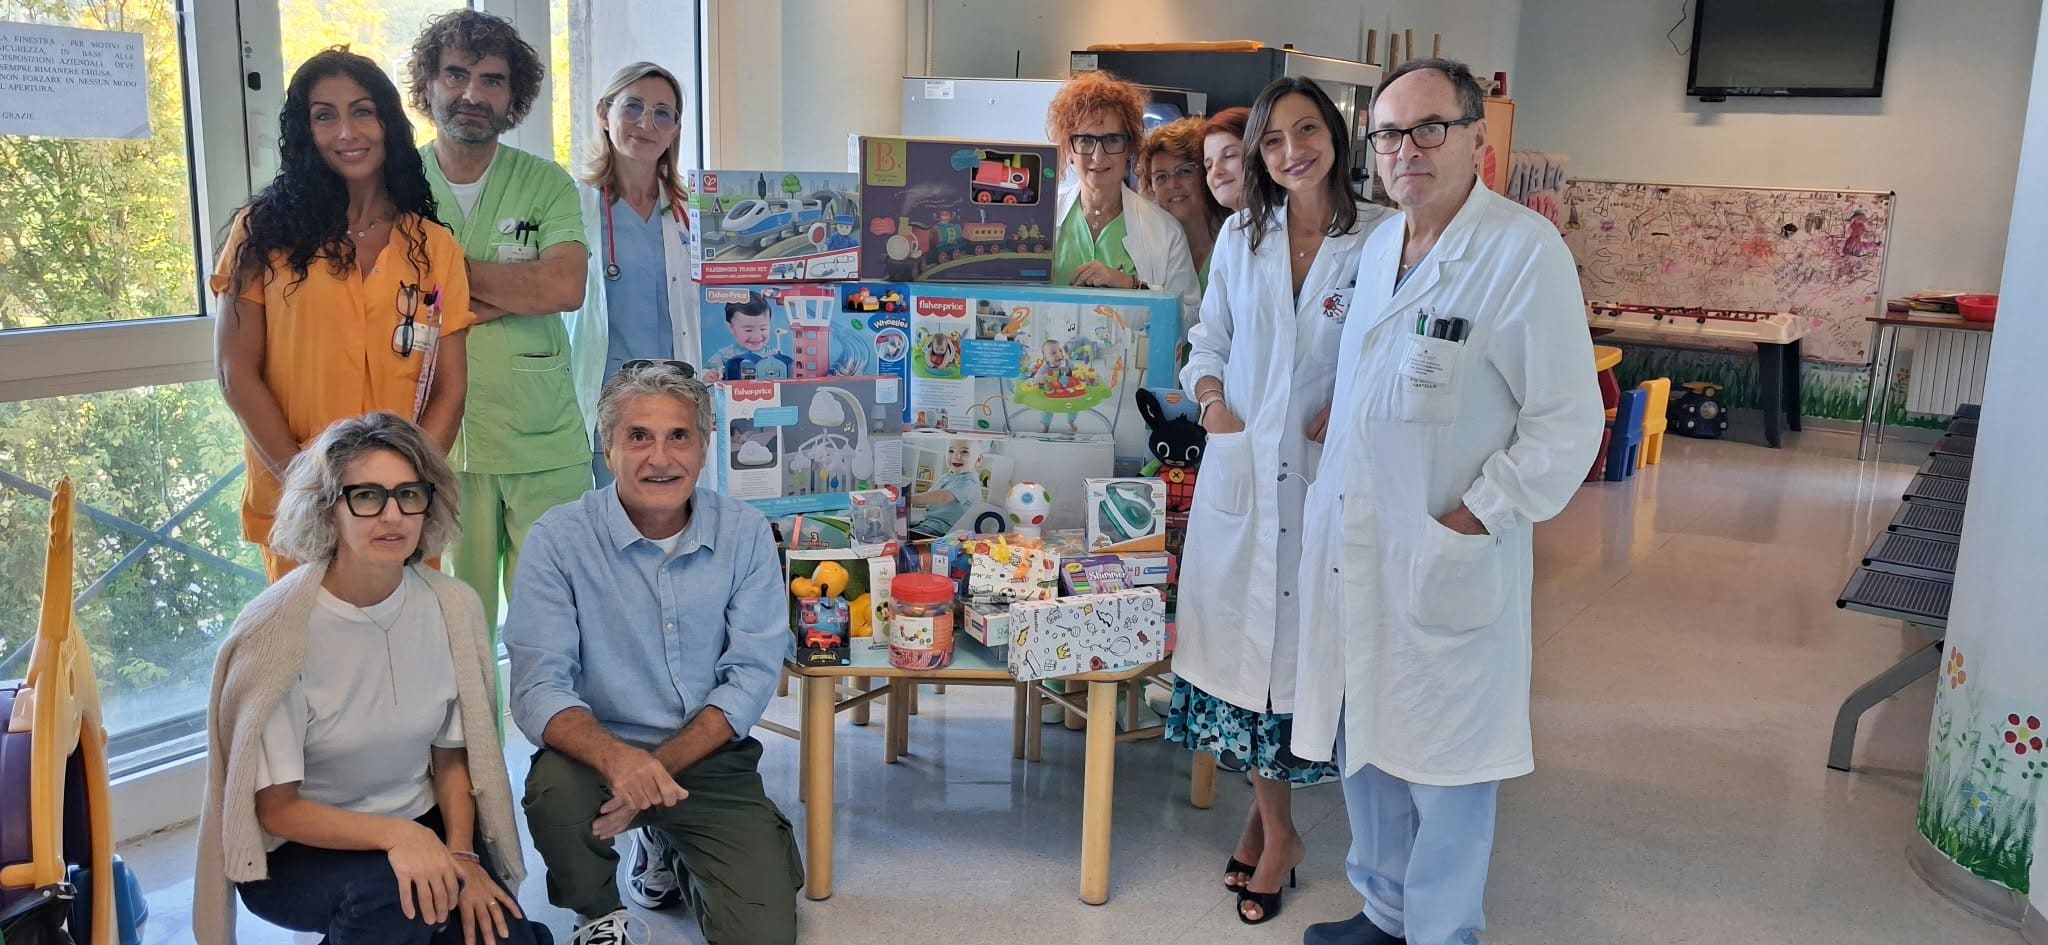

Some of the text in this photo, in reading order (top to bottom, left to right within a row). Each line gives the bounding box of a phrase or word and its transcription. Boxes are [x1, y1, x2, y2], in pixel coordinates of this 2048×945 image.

[14, 35, 55, 45] FINESTRA
[70, 40, 84, 48] PER
[91, 42, 120, 50] MOTIVI
[82, 50, 102, 58] BASE
[0, 54, 55, 64] DISPOSIZIONI
[114, 62, 135, 70] DEVE
[0, 64, 32, 73] SEMPRE
[34, 66, 79, 75] RIMANERE
[22, 75, 61, 83] FORZARE
[78, 78, 110, 86] NESSUN
[113, 80, 137, 88] MODO
[919, 299, 964, 312] fisher-price
[734, 387, 773, 397] fisher-price
[1088, 570, 1126, 582] Shimmer
